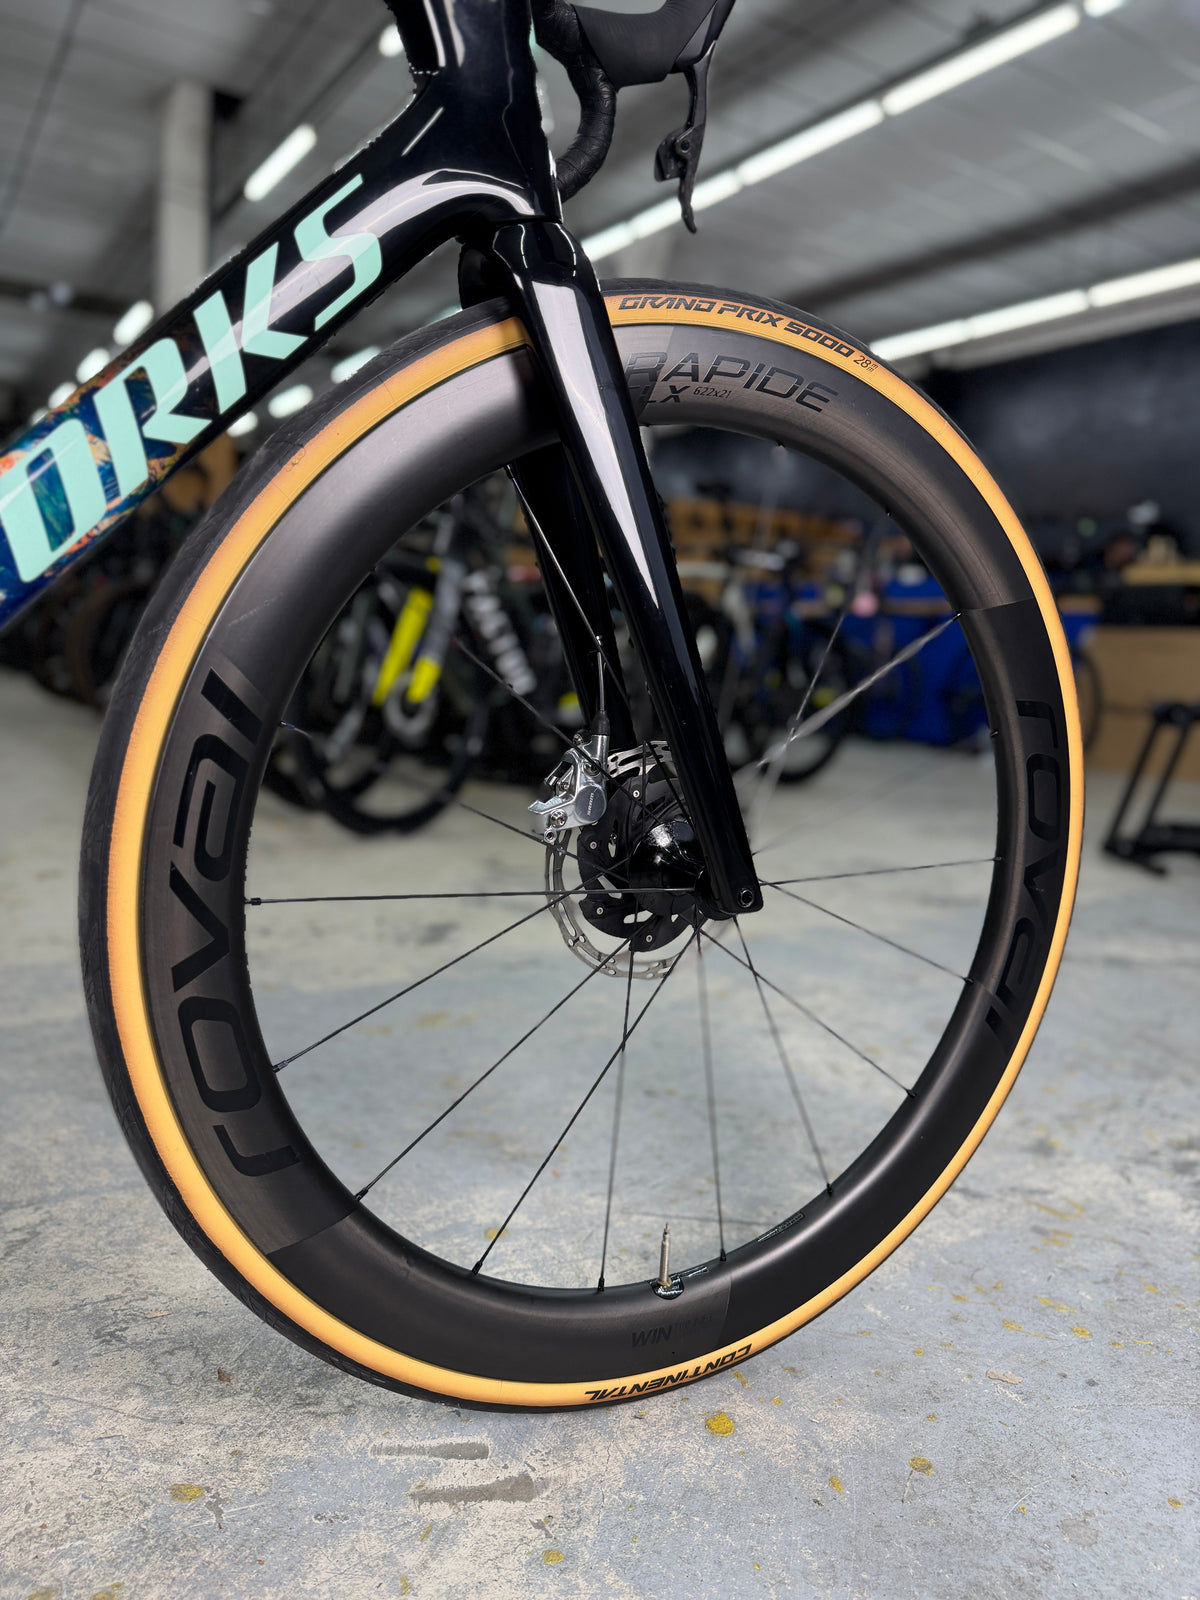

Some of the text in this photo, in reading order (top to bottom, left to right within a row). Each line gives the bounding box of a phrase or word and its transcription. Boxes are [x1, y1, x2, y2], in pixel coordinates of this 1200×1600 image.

[618, 296, 716, 313] GRAND
[717, 302, 785, 328] PRIX
[783, 321, 856, 358] 5000
[625, 352, 839, 413] RAPIDE
[584, 1343, 752, 1401] CONTINENTAL
